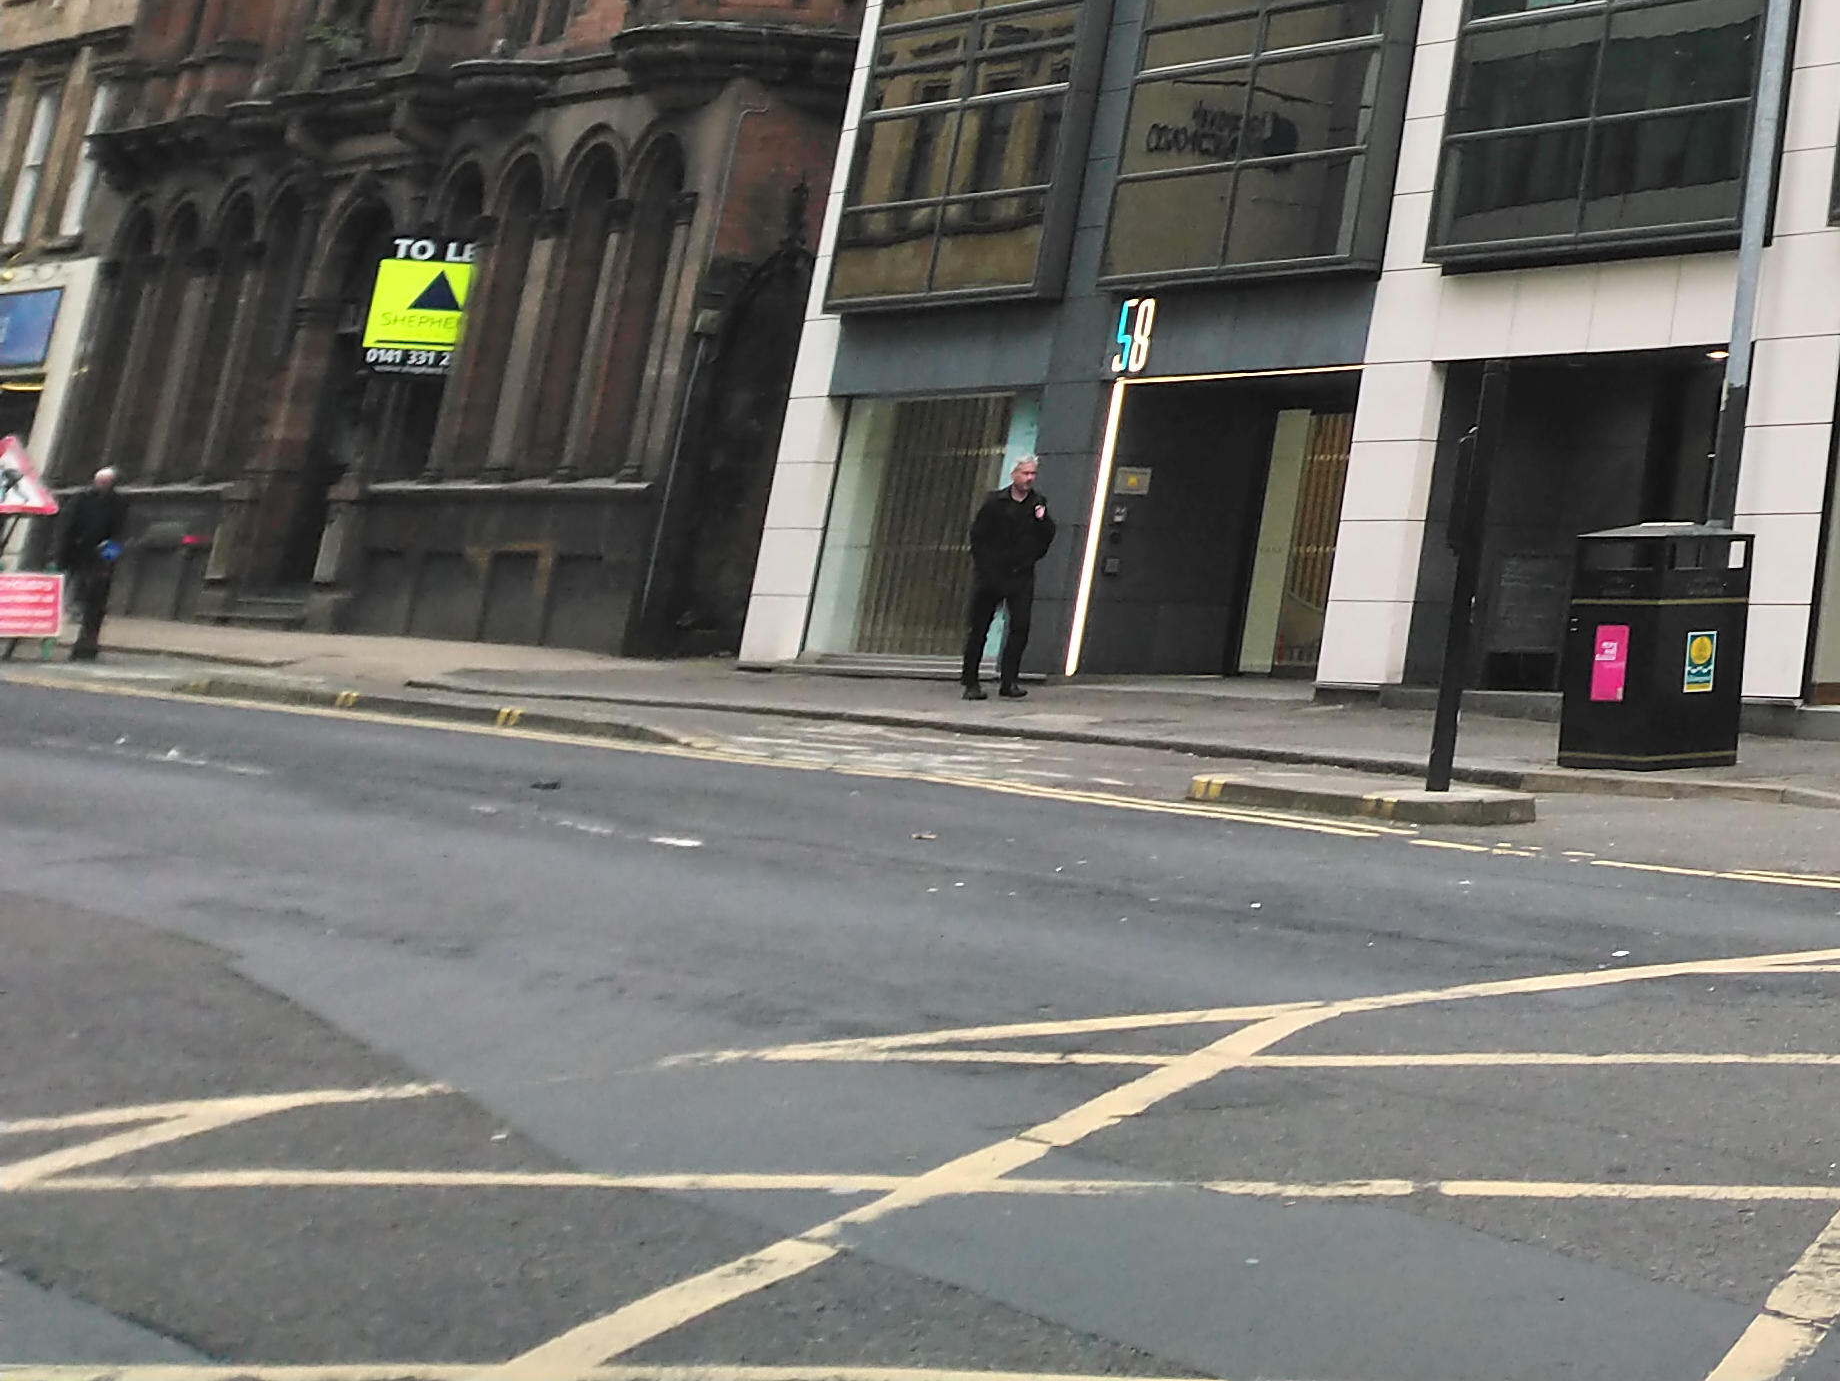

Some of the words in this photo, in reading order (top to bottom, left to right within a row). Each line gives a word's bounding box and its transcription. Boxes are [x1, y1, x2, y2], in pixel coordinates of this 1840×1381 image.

[394, 238, 435, 260] TO
[445, 242, 477, 262] LE
[380, 311, 461, 329] SHEPHE
[1111, 298, 1156, 373] 58
[365, 348, 403, 364] 0141
[407, 350, 436, 365] 331
